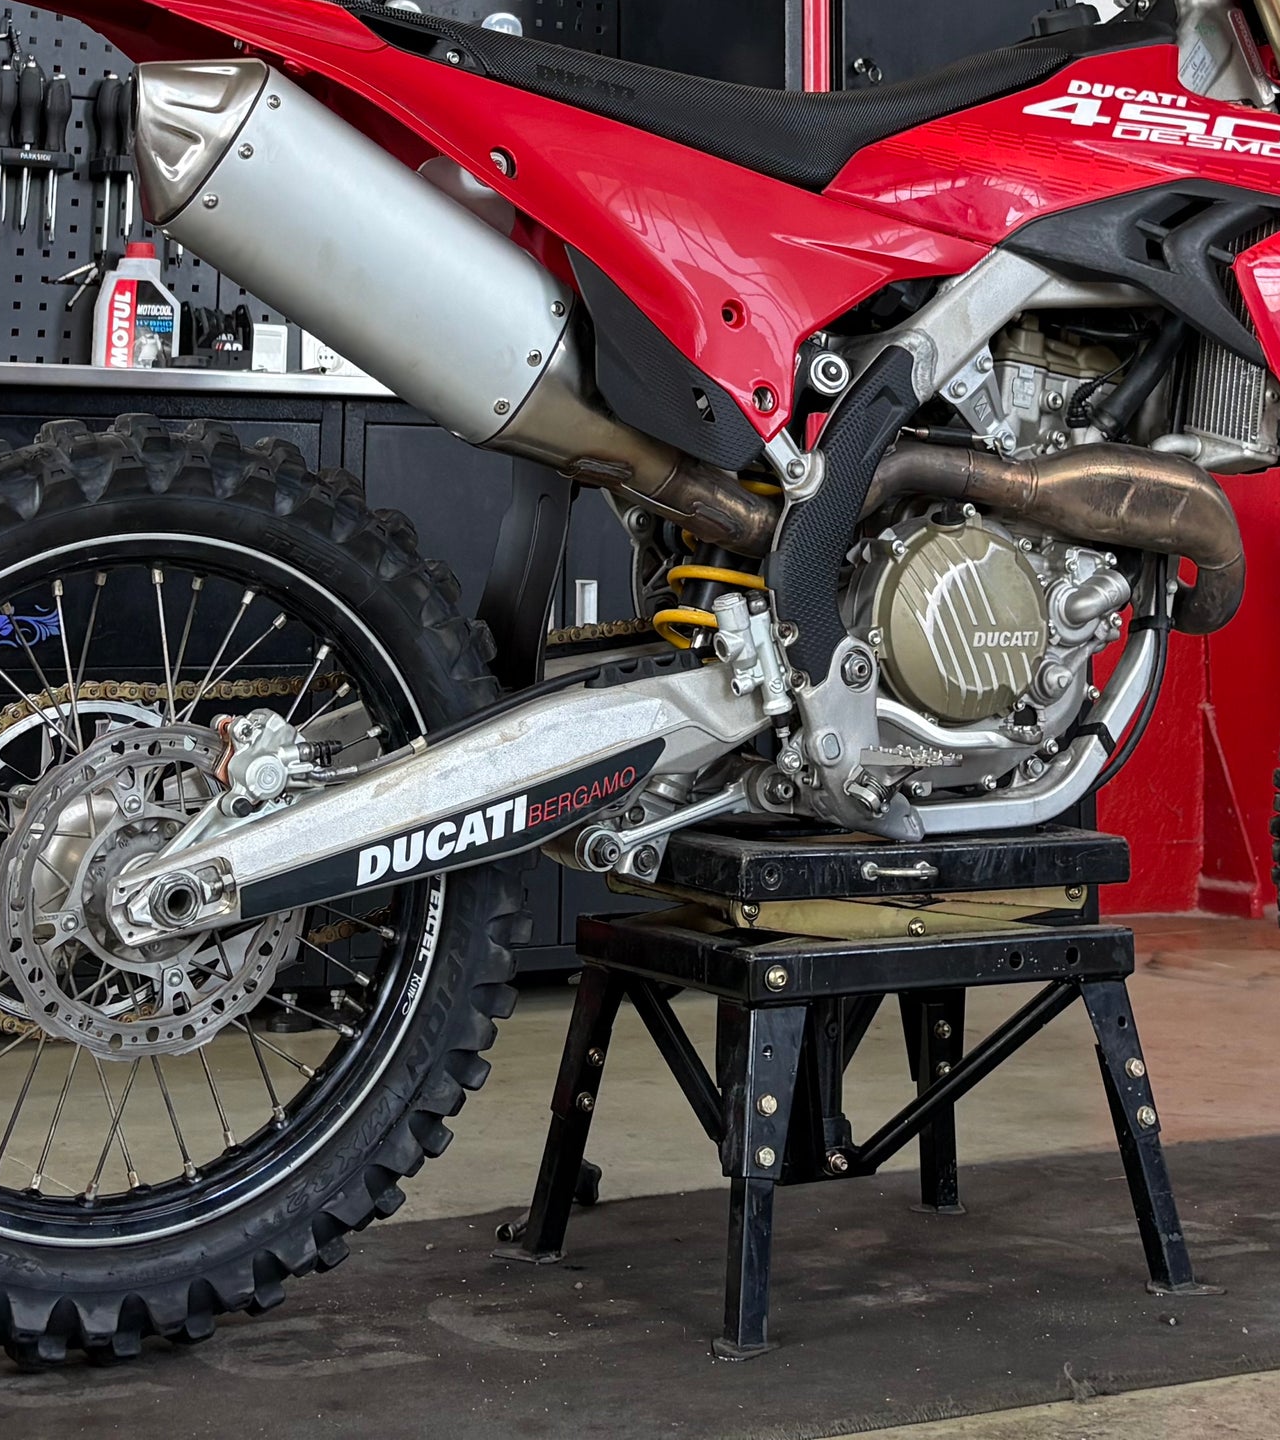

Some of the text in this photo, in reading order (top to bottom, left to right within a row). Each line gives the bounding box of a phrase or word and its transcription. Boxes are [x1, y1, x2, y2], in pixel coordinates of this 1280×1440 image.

[1067, 79, 1188, 108] DUCATI
[109, 291, 132, 368] MOTUL
[137, 304, 173, 316] MOTOCOOL
[972, 631, 1039, 647] DUCATI
[356, 765, 637, 887] DUCATI BERGAMO
[418, 888, 441, 962] EXCEL
